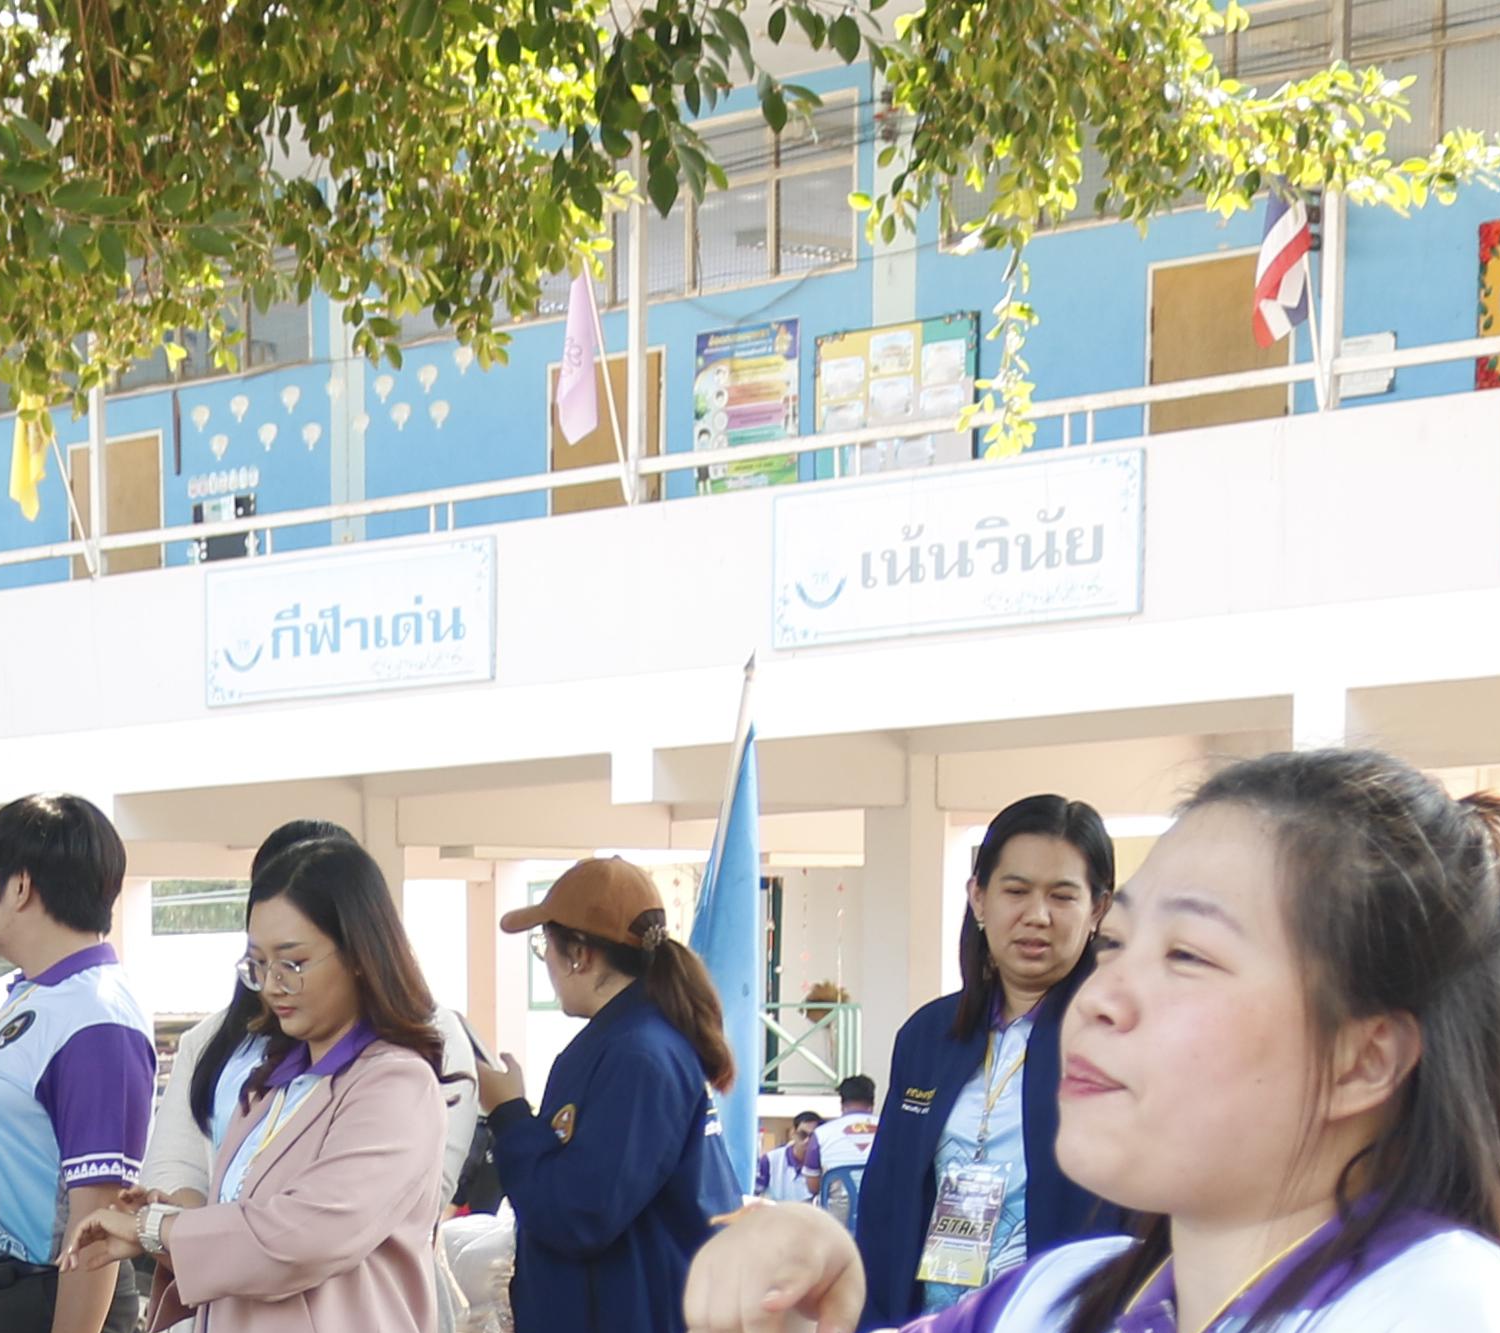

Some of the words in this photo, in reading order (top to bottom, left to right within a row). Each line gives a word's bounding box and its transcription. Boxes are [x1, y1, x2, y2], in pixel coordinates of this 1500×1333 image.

[859, 506, 1105, 590] เน้นวินัย
[270, 594, 467, 660] กีฬาเด่น
[935, 1216, 993, 1237] STAFF
